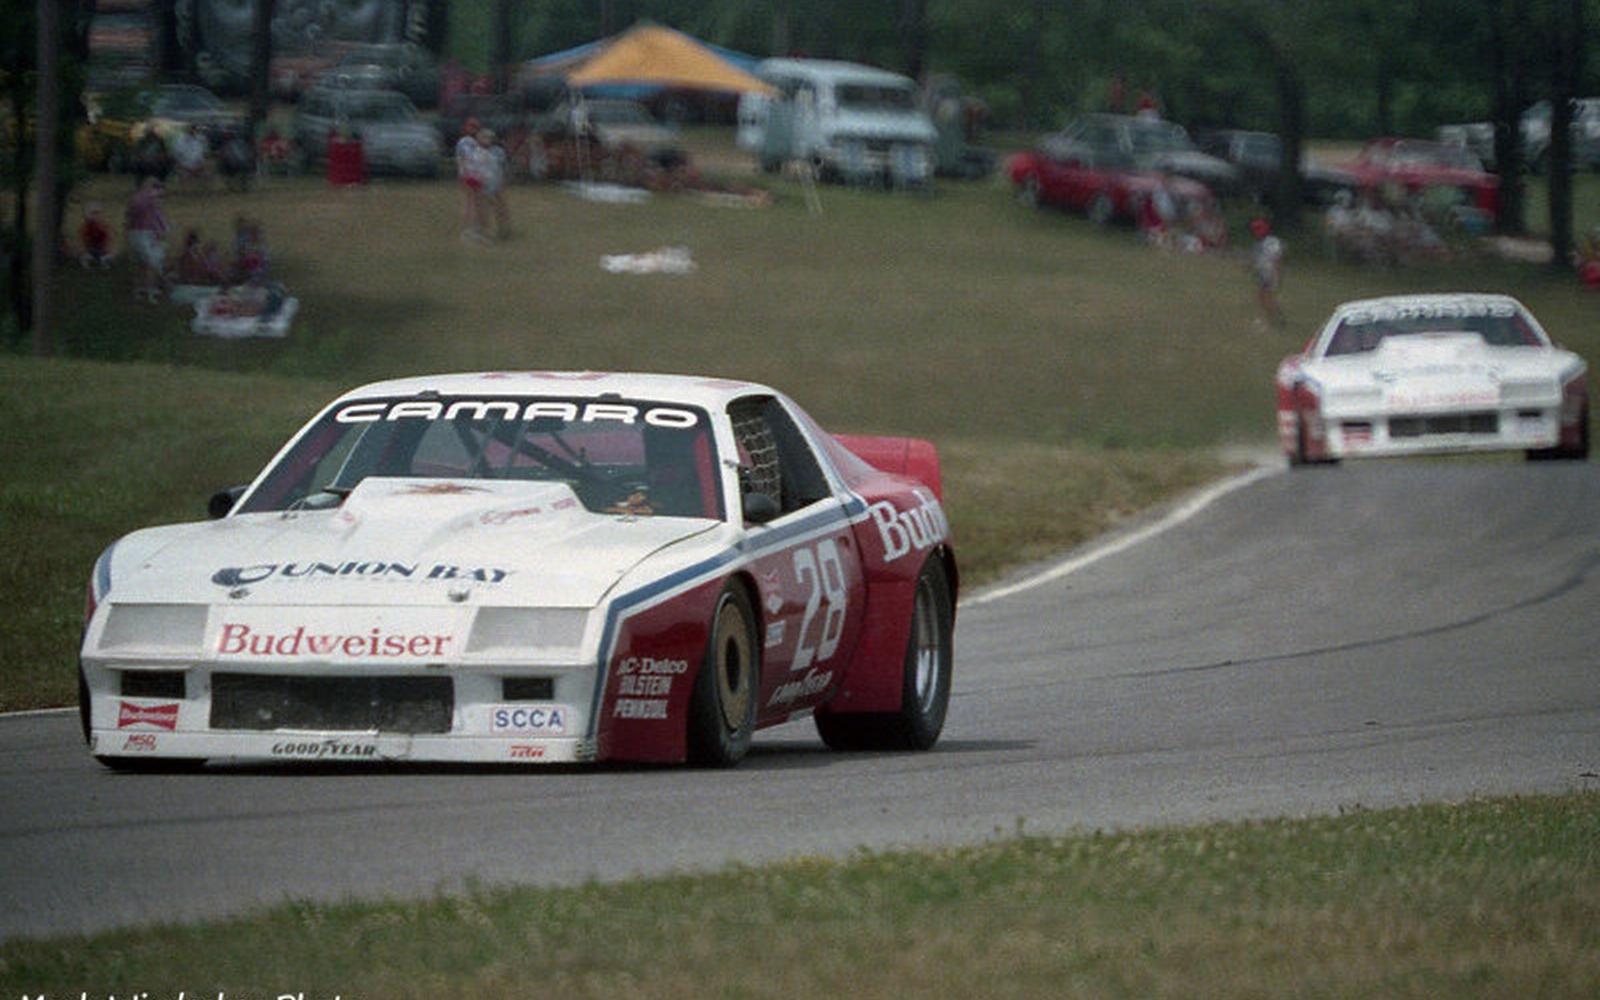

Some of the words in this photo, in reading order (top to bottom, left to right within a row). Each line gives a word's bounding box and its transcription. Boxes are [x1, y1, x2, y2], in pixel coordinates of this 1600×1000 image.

[336, 401, 698, 428] CAMARO
[281, 561, 418, 579] UNION
[426, 564, 516, 584] BAY
[792, 541, 847, 671] 28
[218, 625, 452, 658] Budweiser
[495, 710, 563, 729] SCCA
